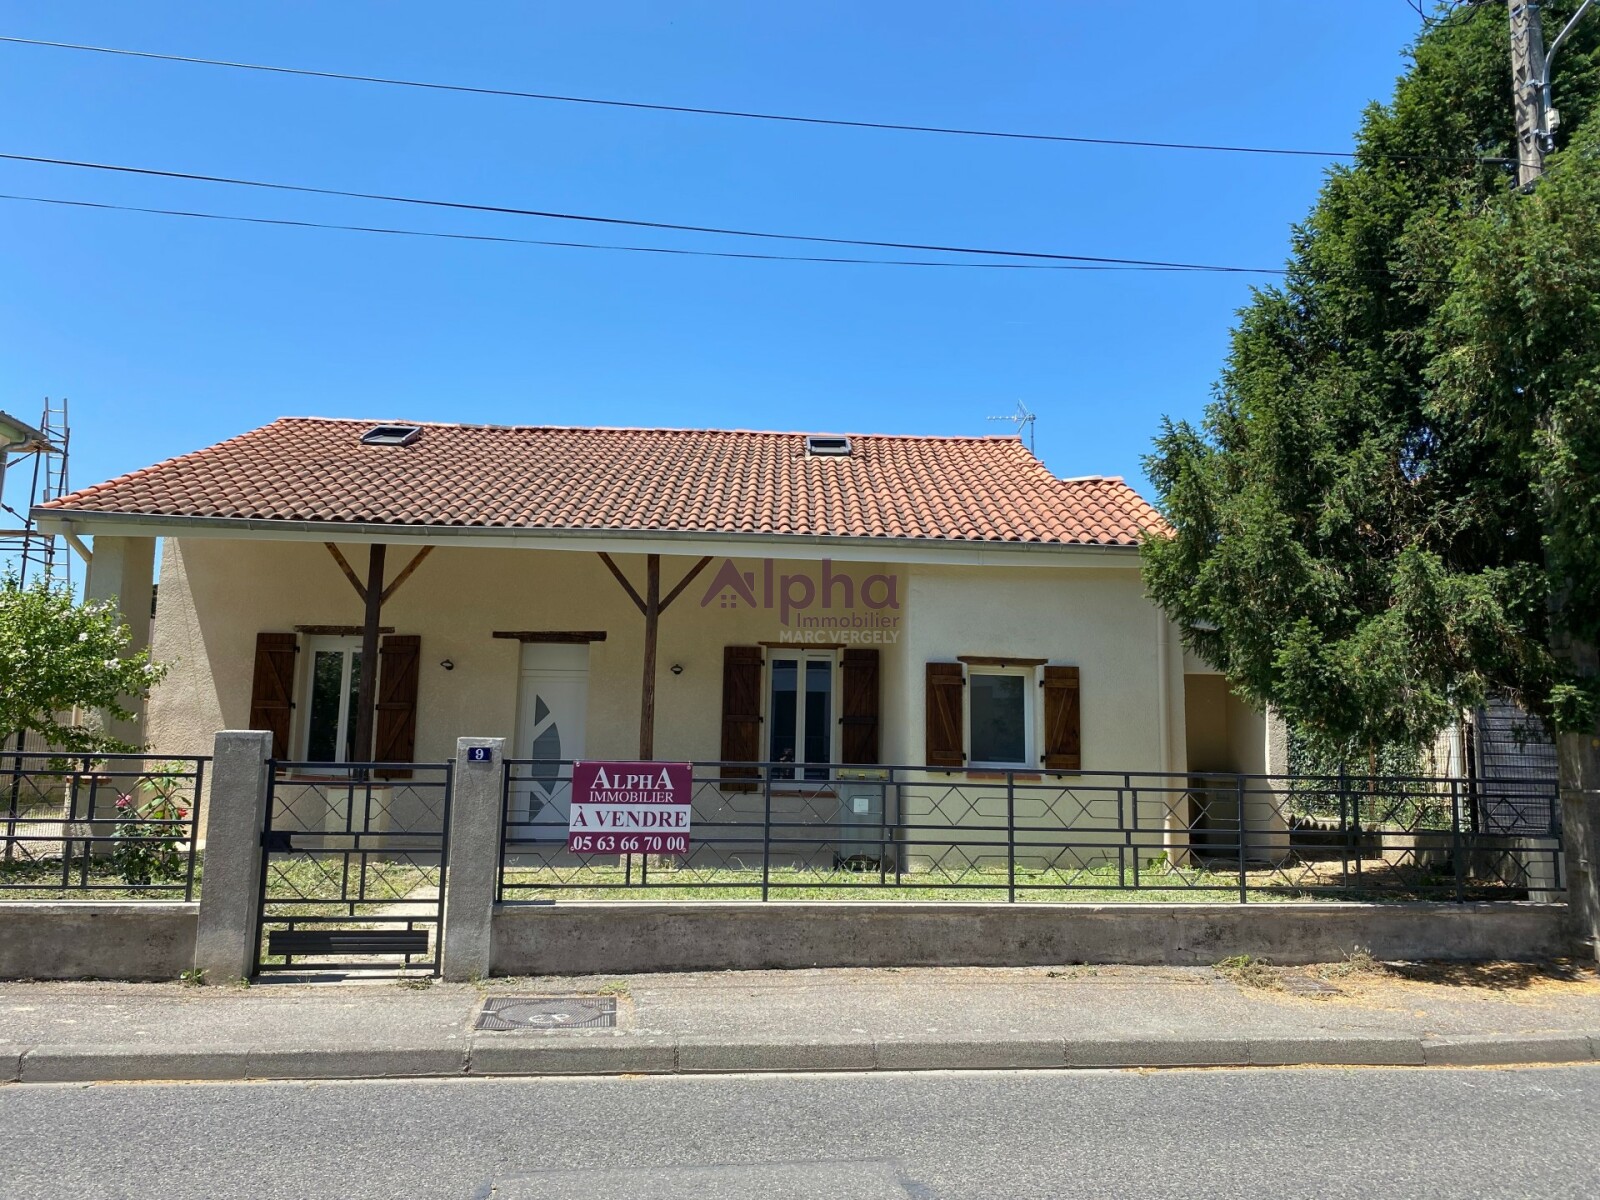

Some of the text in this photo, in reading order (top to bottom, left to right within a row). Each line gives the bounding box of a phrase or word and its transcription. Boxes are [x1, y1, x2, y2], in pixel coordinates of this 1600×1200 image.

[475, 748, 484, 760] 9
[590, 766, 675, 790] ALPHA
[589, 791, 674, 803] IMMOBILIER
[572, 805, 688, 828] À VENDRE
[573, 836, 685, 851] 05 63 66 70 00
